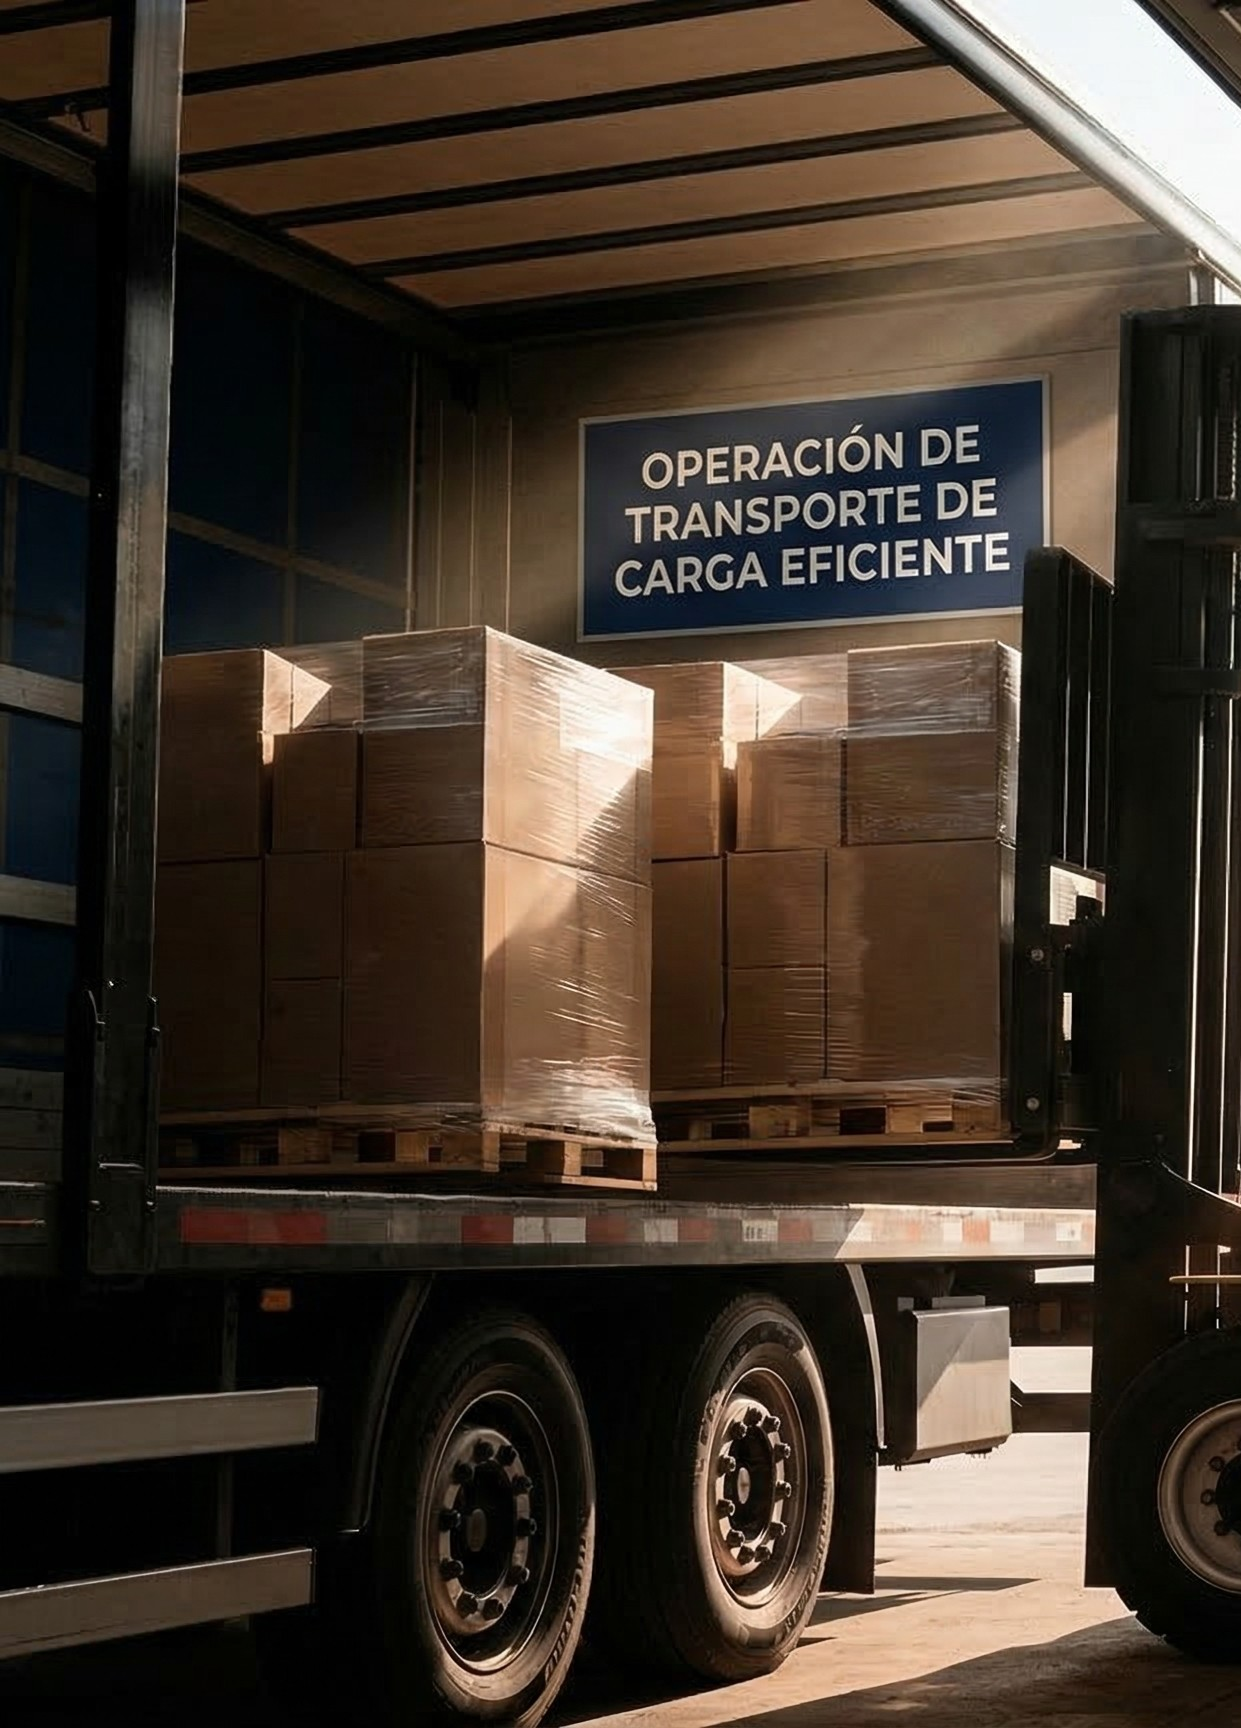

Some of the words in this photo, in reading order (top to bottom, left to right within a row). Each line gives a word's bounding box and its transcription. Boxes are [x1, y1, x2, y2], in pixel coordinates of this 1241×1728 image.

[641, 424, 904, 490] OPERACIÓN
[920, 424, 980, 467] DE
[625, 485, 921, 544] TRANSPORTE
[936, 478, 997, 521] DE
[614, 551, 768, 598] CARGA
[781, 532, 1010, 586] EFICIENTE
